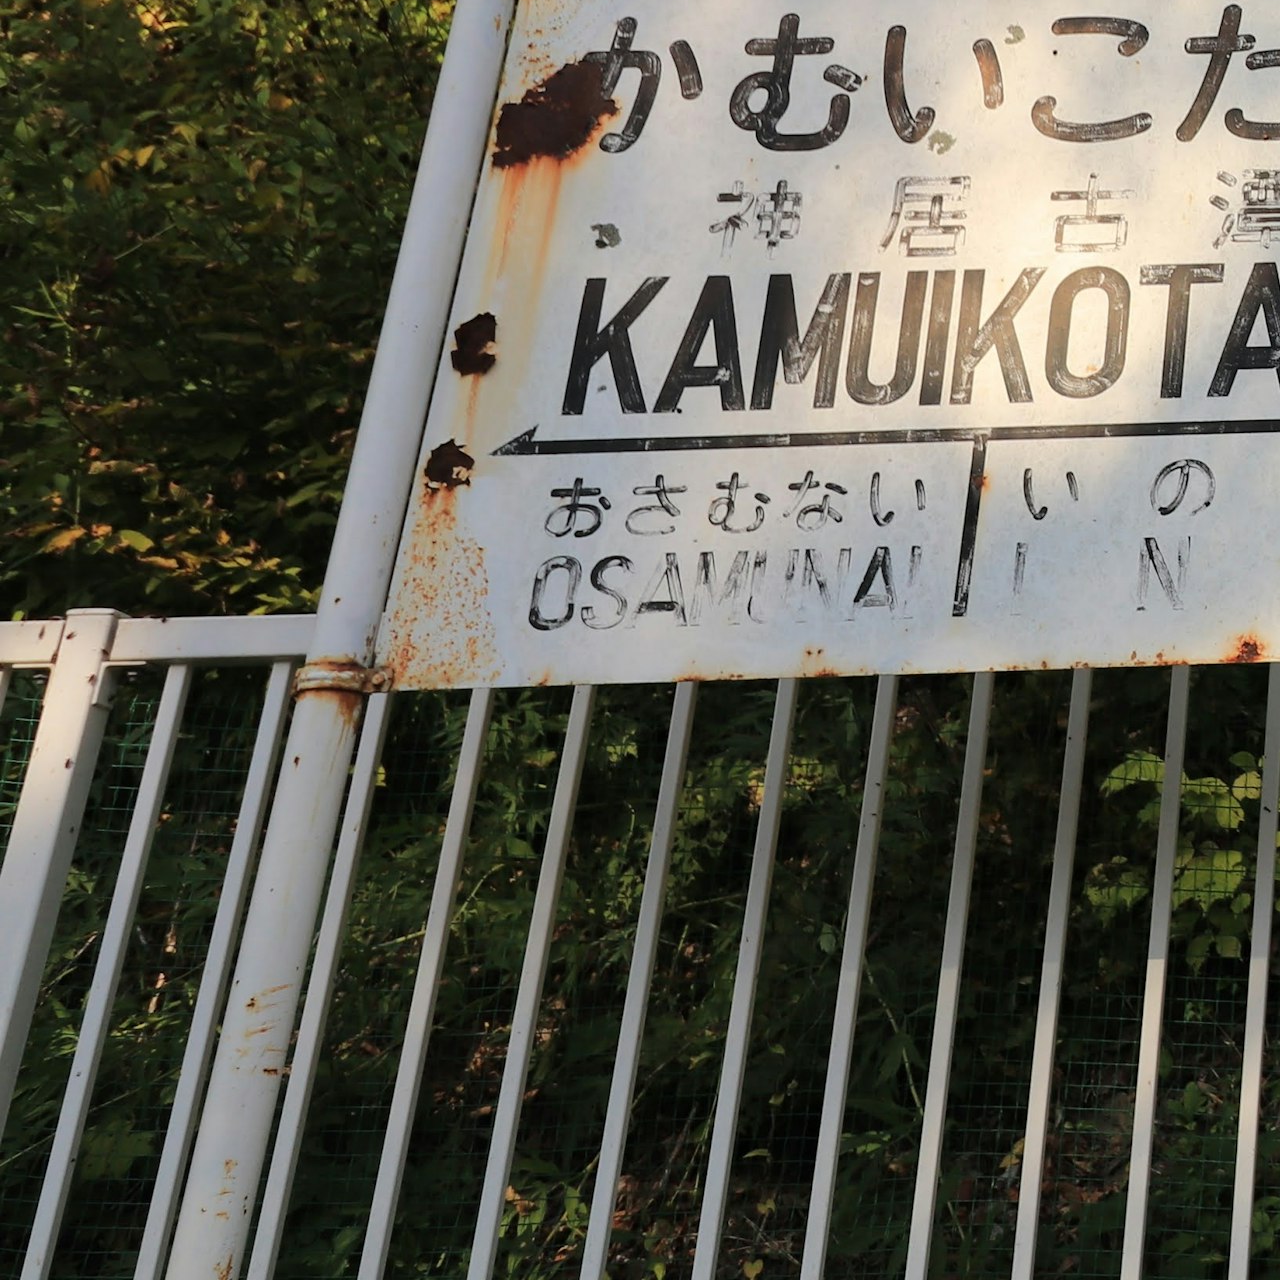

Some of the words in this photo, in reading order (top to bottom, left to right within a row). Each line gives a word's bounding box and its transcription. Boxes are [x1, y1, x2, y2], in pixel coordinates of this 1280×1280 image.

[544, 471, 927, 538] おさむない
